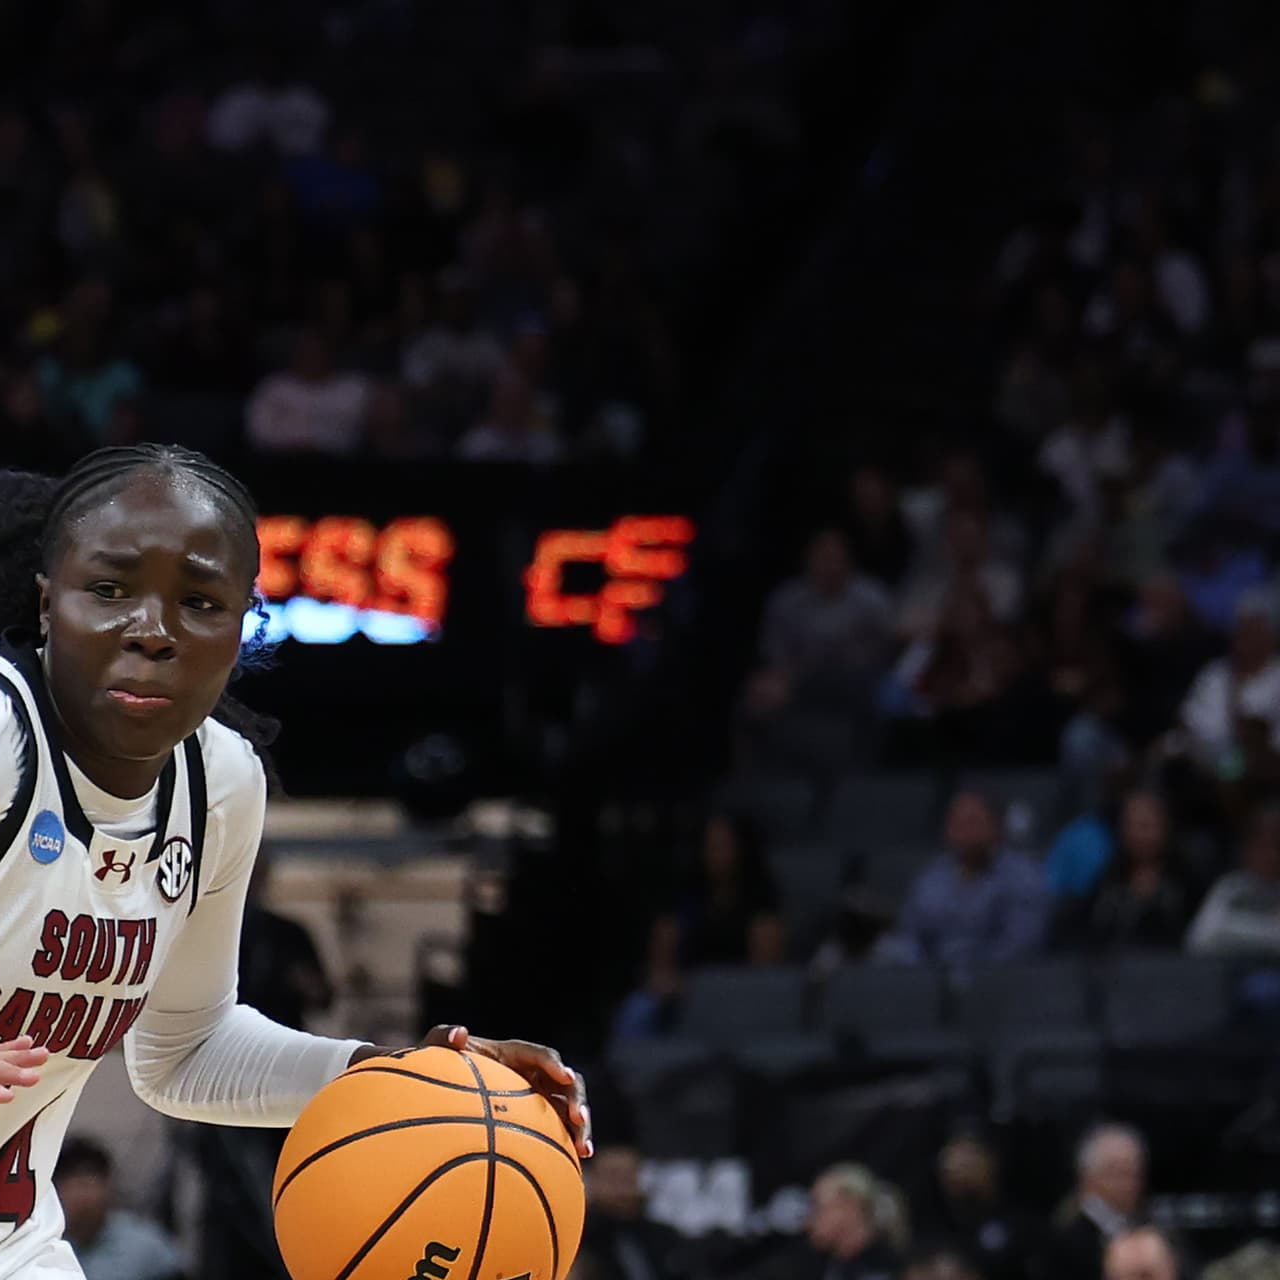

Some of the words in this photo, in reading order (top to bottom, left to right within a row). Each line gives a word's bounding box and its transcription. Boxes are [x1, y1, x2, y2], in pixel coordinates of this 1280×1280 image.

[31, 831, 62, 854] NCAA
[159, 841, 191, 898] SEC
[31, 908, 157, 986] SOUTH
